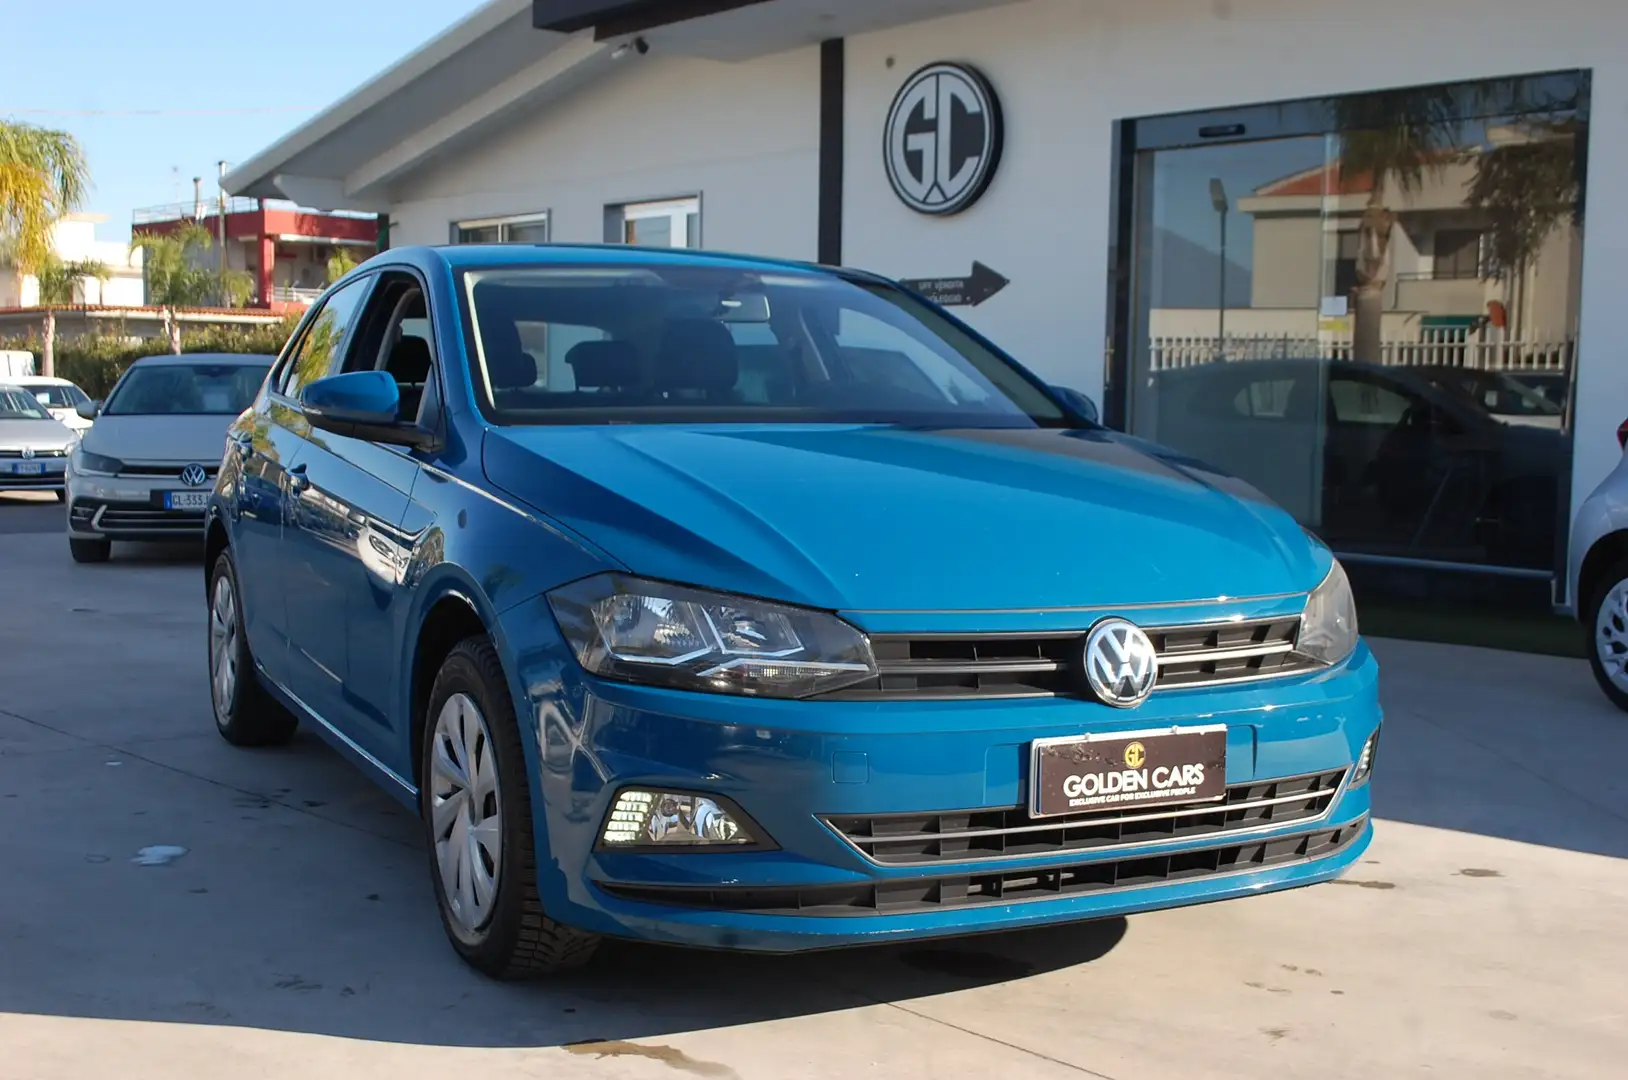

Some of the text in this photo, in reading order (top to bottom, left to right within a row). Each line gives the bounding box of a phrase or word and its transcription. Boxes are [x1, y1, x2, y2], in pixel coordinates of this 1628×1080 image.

[1063, 763, 1205, 798] GOLDEN CARS
[1069, 786, 1197, 807] EXCLUSIVE CAR FOR EXCLUSIVE PEOPLE
